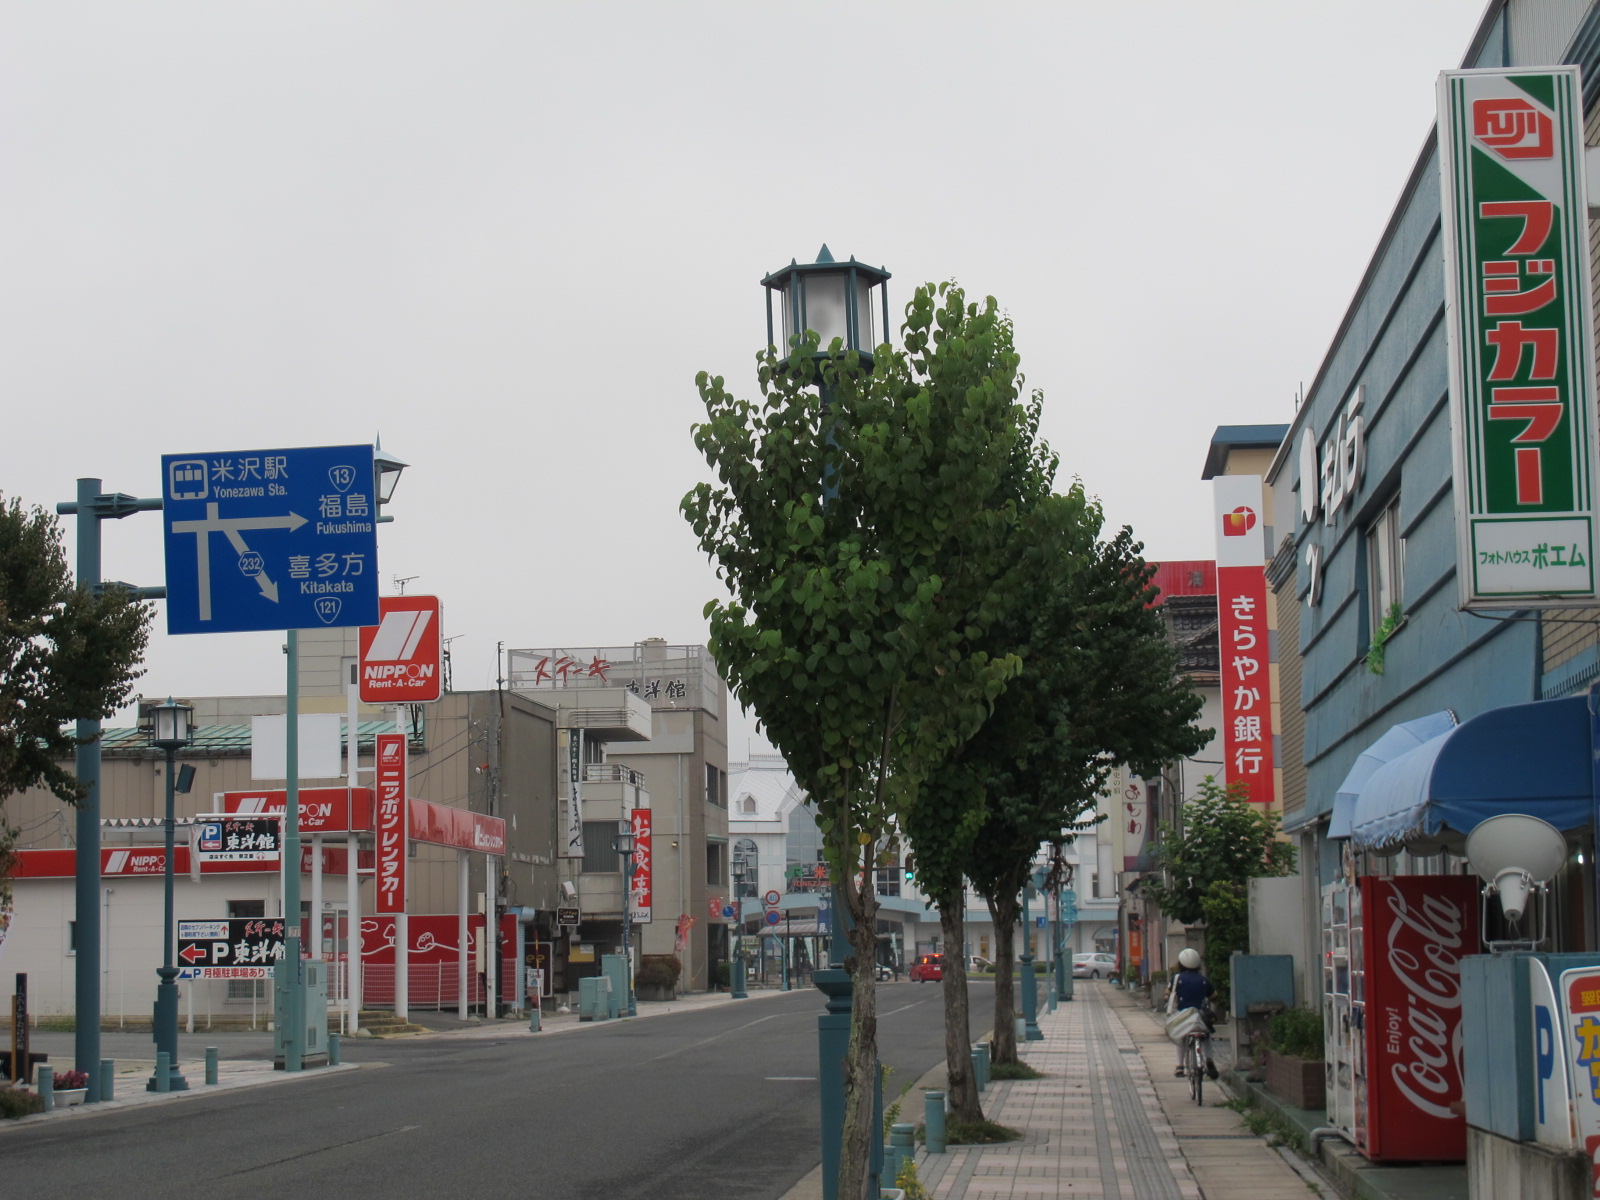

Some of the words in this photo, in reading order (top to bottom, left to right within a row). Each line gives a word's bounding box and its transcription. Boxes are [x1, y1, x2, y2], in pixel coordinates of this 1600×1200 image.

[1480, 201, 1564, 505] フジカラー
[211, 456, 289, 482] 米沢駅
[333, 468, 350, 484] 13
[213, 487, 264, 498] Yonezawa
[268, 484, 288, 496] Sta.
[318, 492, 369, 518] 福島
[316, 522, 372, 535] Fukushima
[242, 558, 260, 570] 232
[288, 552, 365, 579] 喜多方
[300, 580, 354, 594] Kitakata
[319, 602, 336, 613] 121
[364, 663, 434, 680] NIPPON
[534, 655, 611, 685] ステーキ
[1231, 595, 1263, 774] きらやか銀行
[205, 825, 218, 840] P
[226, 832, 275, 851] 東洋館
[381, 771, 399, 906] ニッポンレンタカー
[131, 855, 167, 866] NIPPO
[633, 815, 651, 904] お食事
[212, 942, 230, 964] P
[193, 968, 202, 978] P
[203, 967, 265, 978] 月極駐車場あり
[1387, 879, 1464, 1119] Coca-Cola
[1386, 1006, 1400, 1055] Enjoy!
[1535, 1005, 1554, 1124] P
